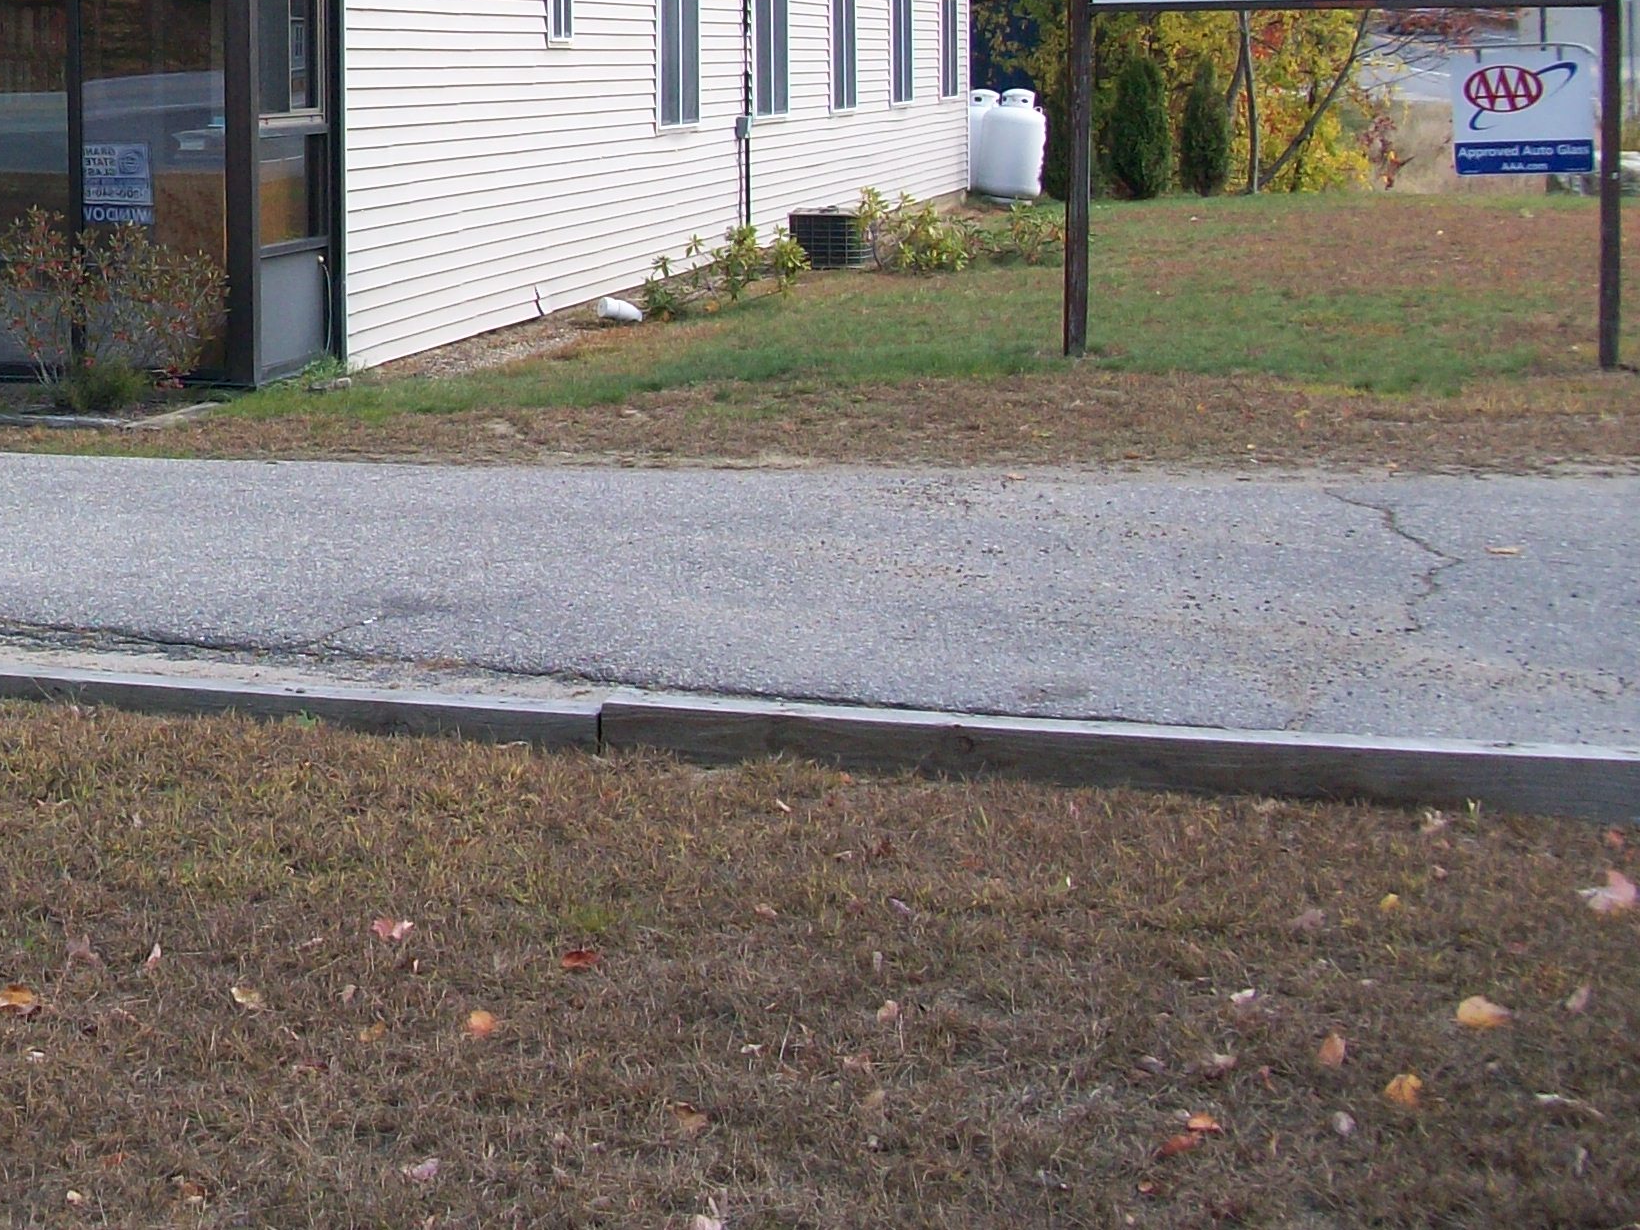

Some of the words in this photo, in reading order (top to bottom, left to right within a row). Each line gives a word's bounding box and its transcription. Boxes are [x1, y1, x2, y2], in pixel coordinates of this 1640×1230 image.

[1473, 66, 1535, 110] AAA
[1458, 146, 1519, 160] Approved
[1522, 145, 1554, 156] Auto
[1557, 144, 1590, 155] Glass
[1501, 161, 1549, 171] AAA.com
